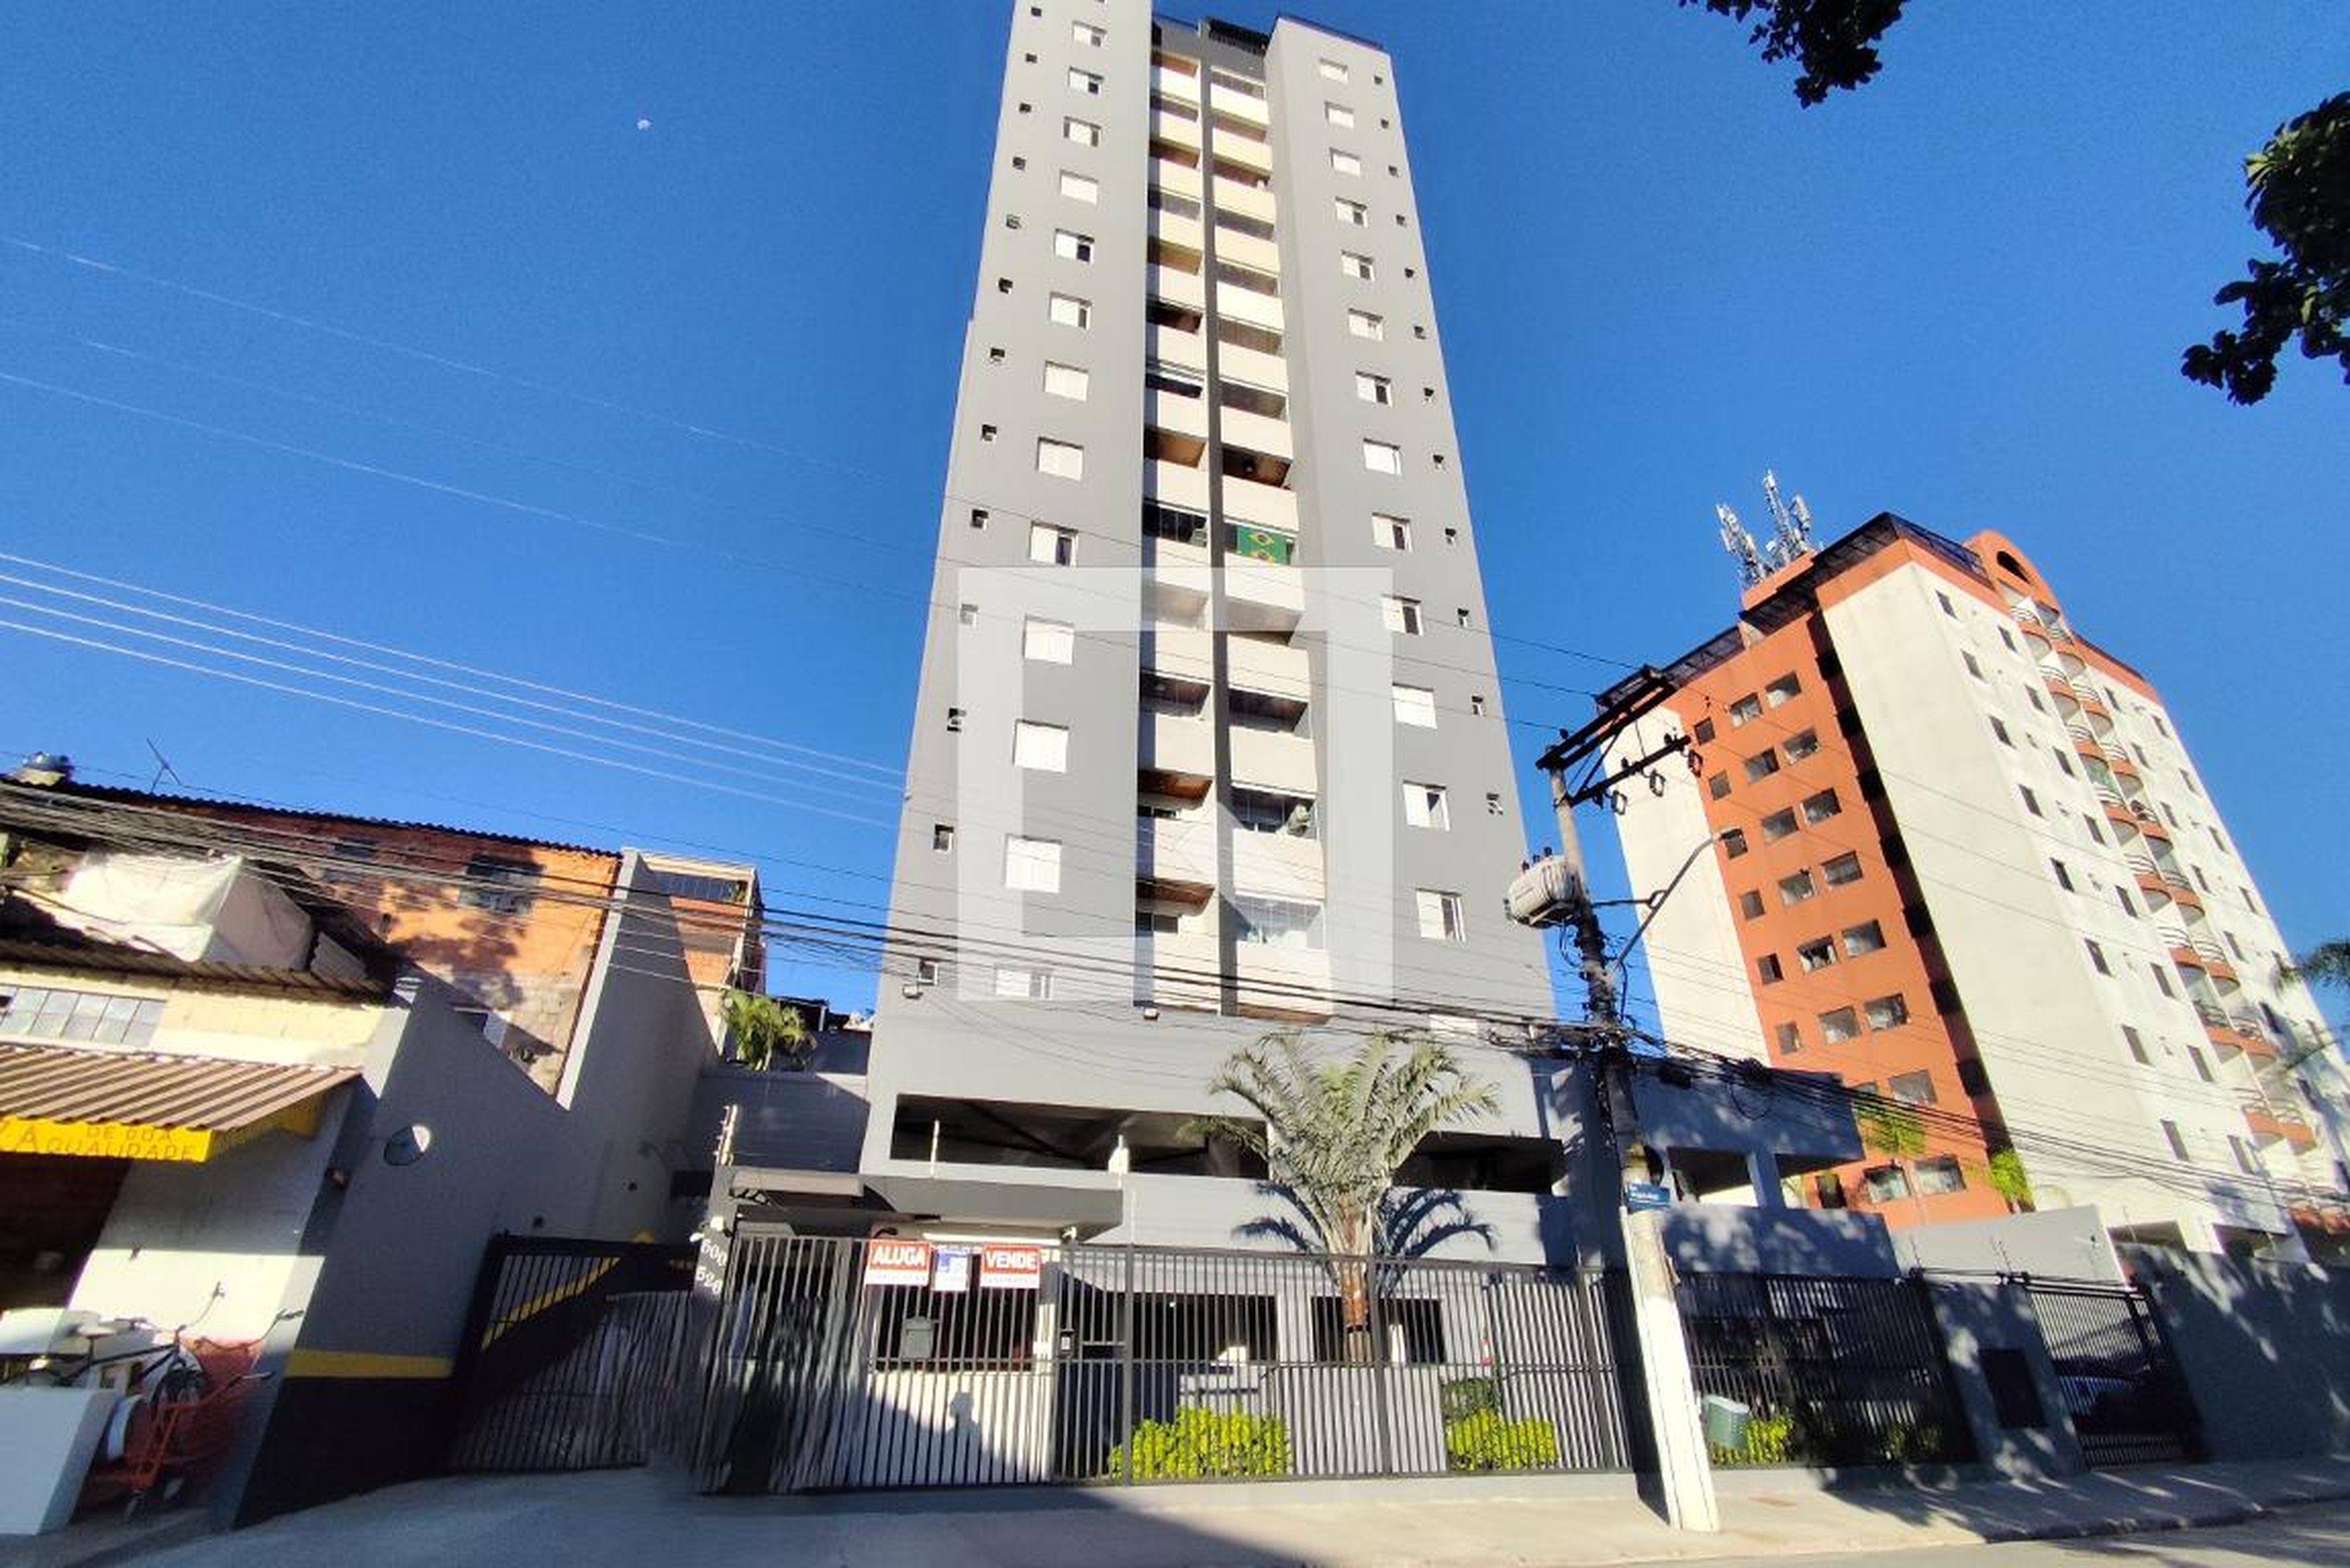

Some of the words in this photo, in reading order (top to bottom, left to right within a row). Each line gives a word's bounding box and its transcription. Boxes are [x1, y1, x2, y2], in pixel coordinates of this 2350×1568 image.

[700, 1239, 728, 1267] 600
[871, 1245, 926, 1266] ALUGA
[985, 1249, 1037, 1271] VENDE
